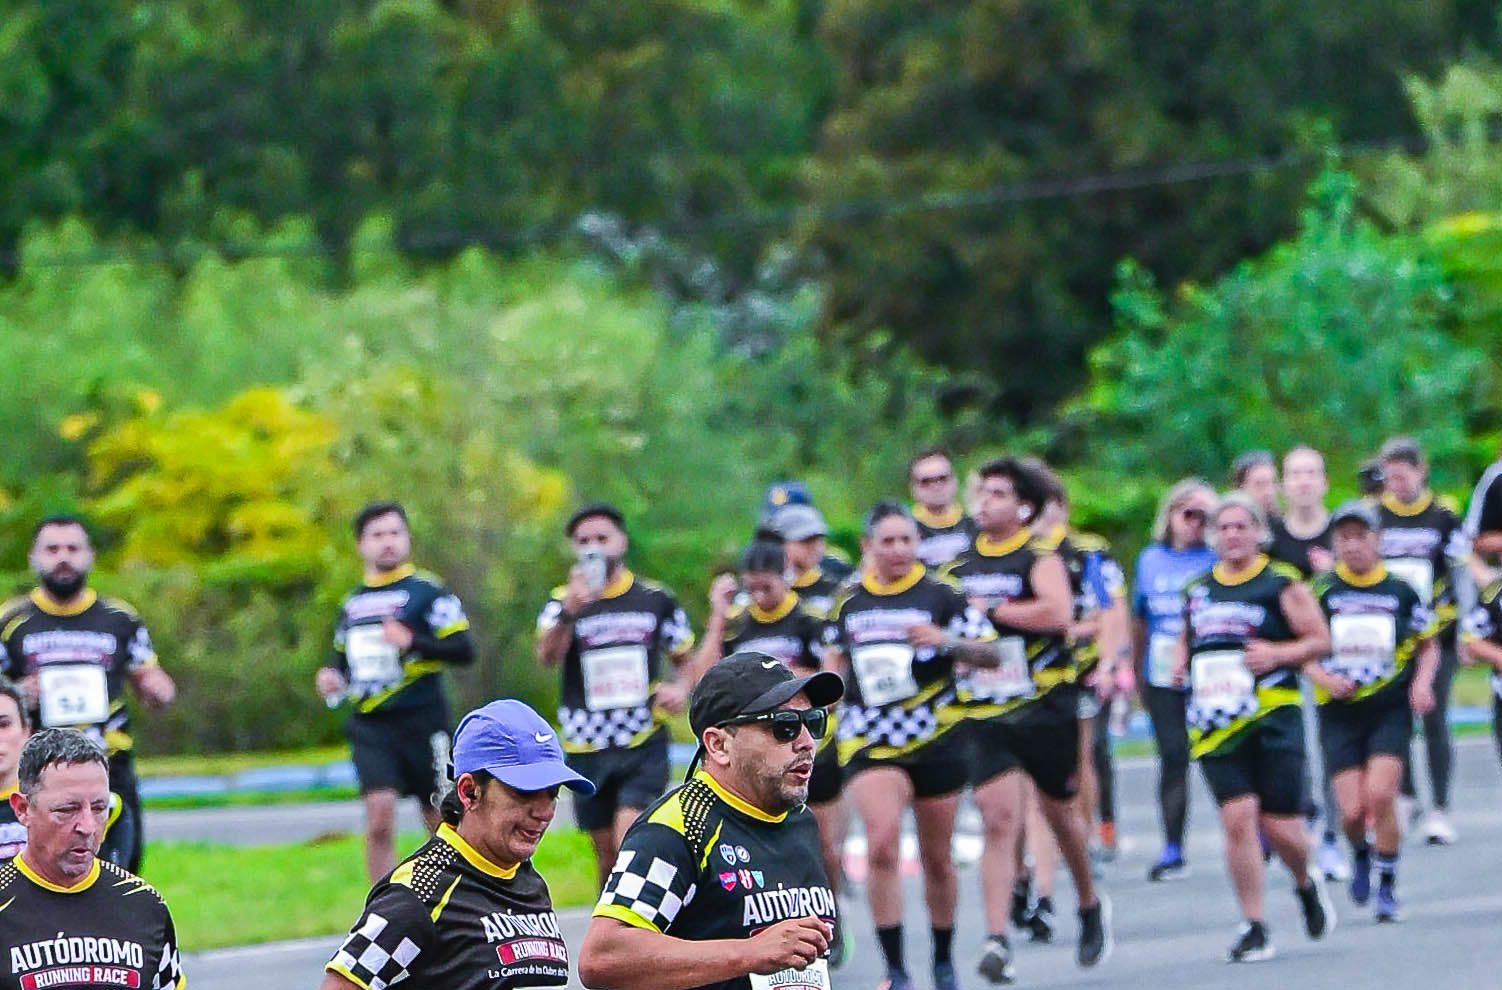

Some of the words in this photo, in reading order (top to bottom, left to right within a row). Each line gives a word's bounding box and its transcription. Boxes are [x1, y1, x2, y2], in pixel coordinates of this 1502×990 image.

[743, 882, 836, 926] AUTÓDROM
[10, 931, 144, 974] AUTÓDROMO
[511, 941, 549, 960] RUNNING
[34, 967, 90, 989] RUNNING
[93, 967, 128, 985] RACE
[488, 969, 500, 978] La
[501, 966, 528, 977] Carrera
